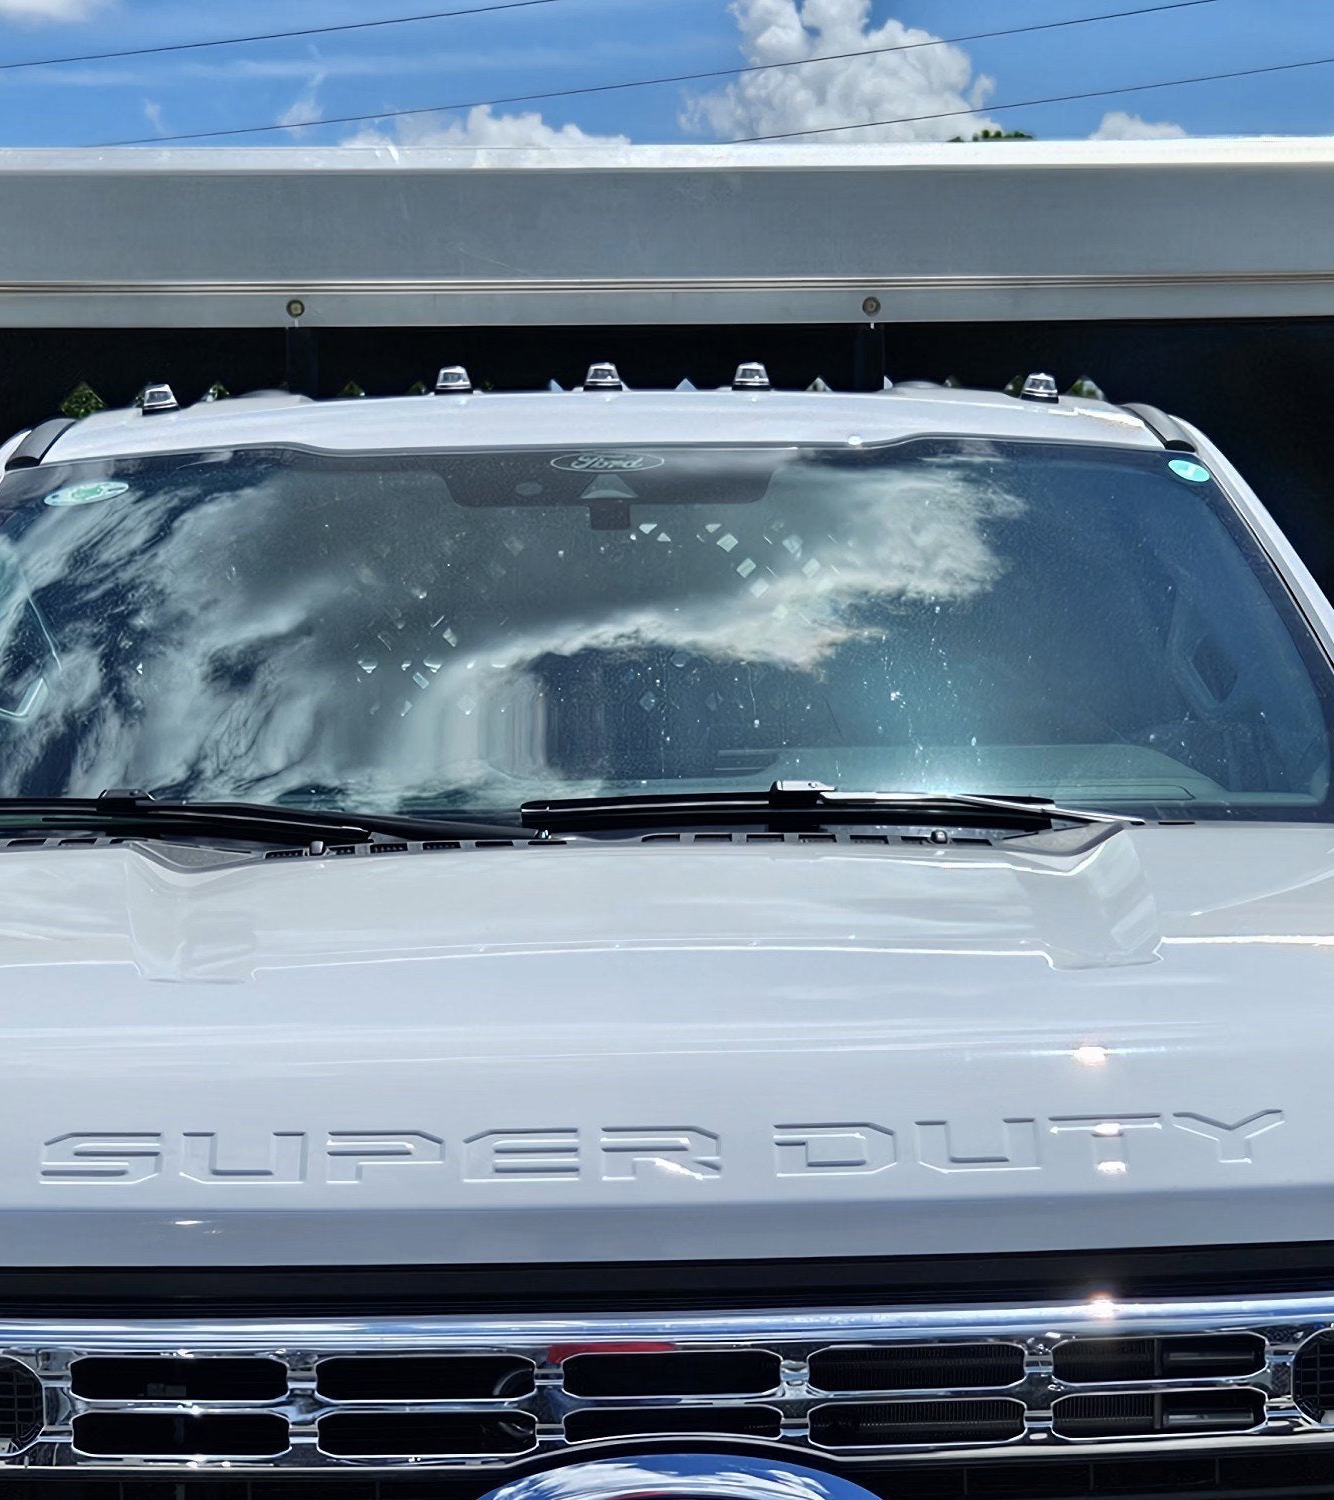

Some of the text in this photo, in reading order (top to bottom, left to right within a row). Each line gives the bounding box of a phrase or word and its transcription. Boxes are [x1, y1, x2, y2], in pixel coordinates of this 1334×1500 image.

[570, 453, 644, 469] Ford
[38, 1109, 1286, 1186] SUPER DUTY
